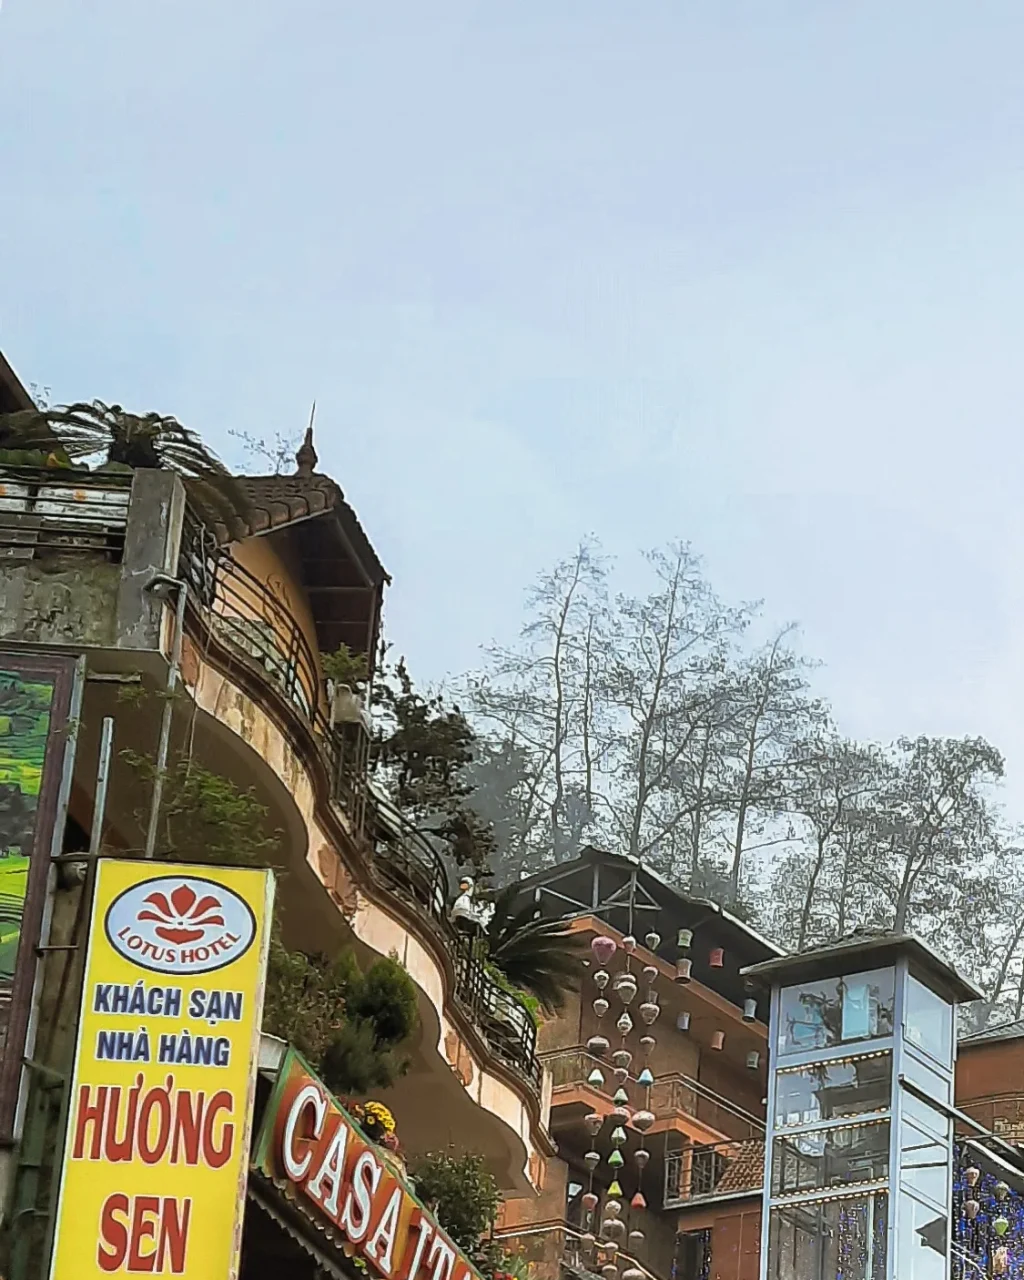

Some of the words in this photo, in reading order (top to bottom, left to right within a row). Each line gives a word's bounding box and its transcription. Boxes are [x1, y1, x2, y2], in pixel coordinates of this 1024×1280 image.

[117, 926, 175, 963] LOTUS
[181, 931, 242, 963] HOTEL
[94, 980, 182, 1017] KHÁCH
[189, 989, 243, 1024] SẠN
[96, 1027, 151, 1063] NHÀ
[159, 1029, 230, 1067] HÀNG
[72, 1073, 234, 1168] HƯƠNG
[282, 1084, 402, 1276] CASA
[97, 1192, 192, 1274] SEN
